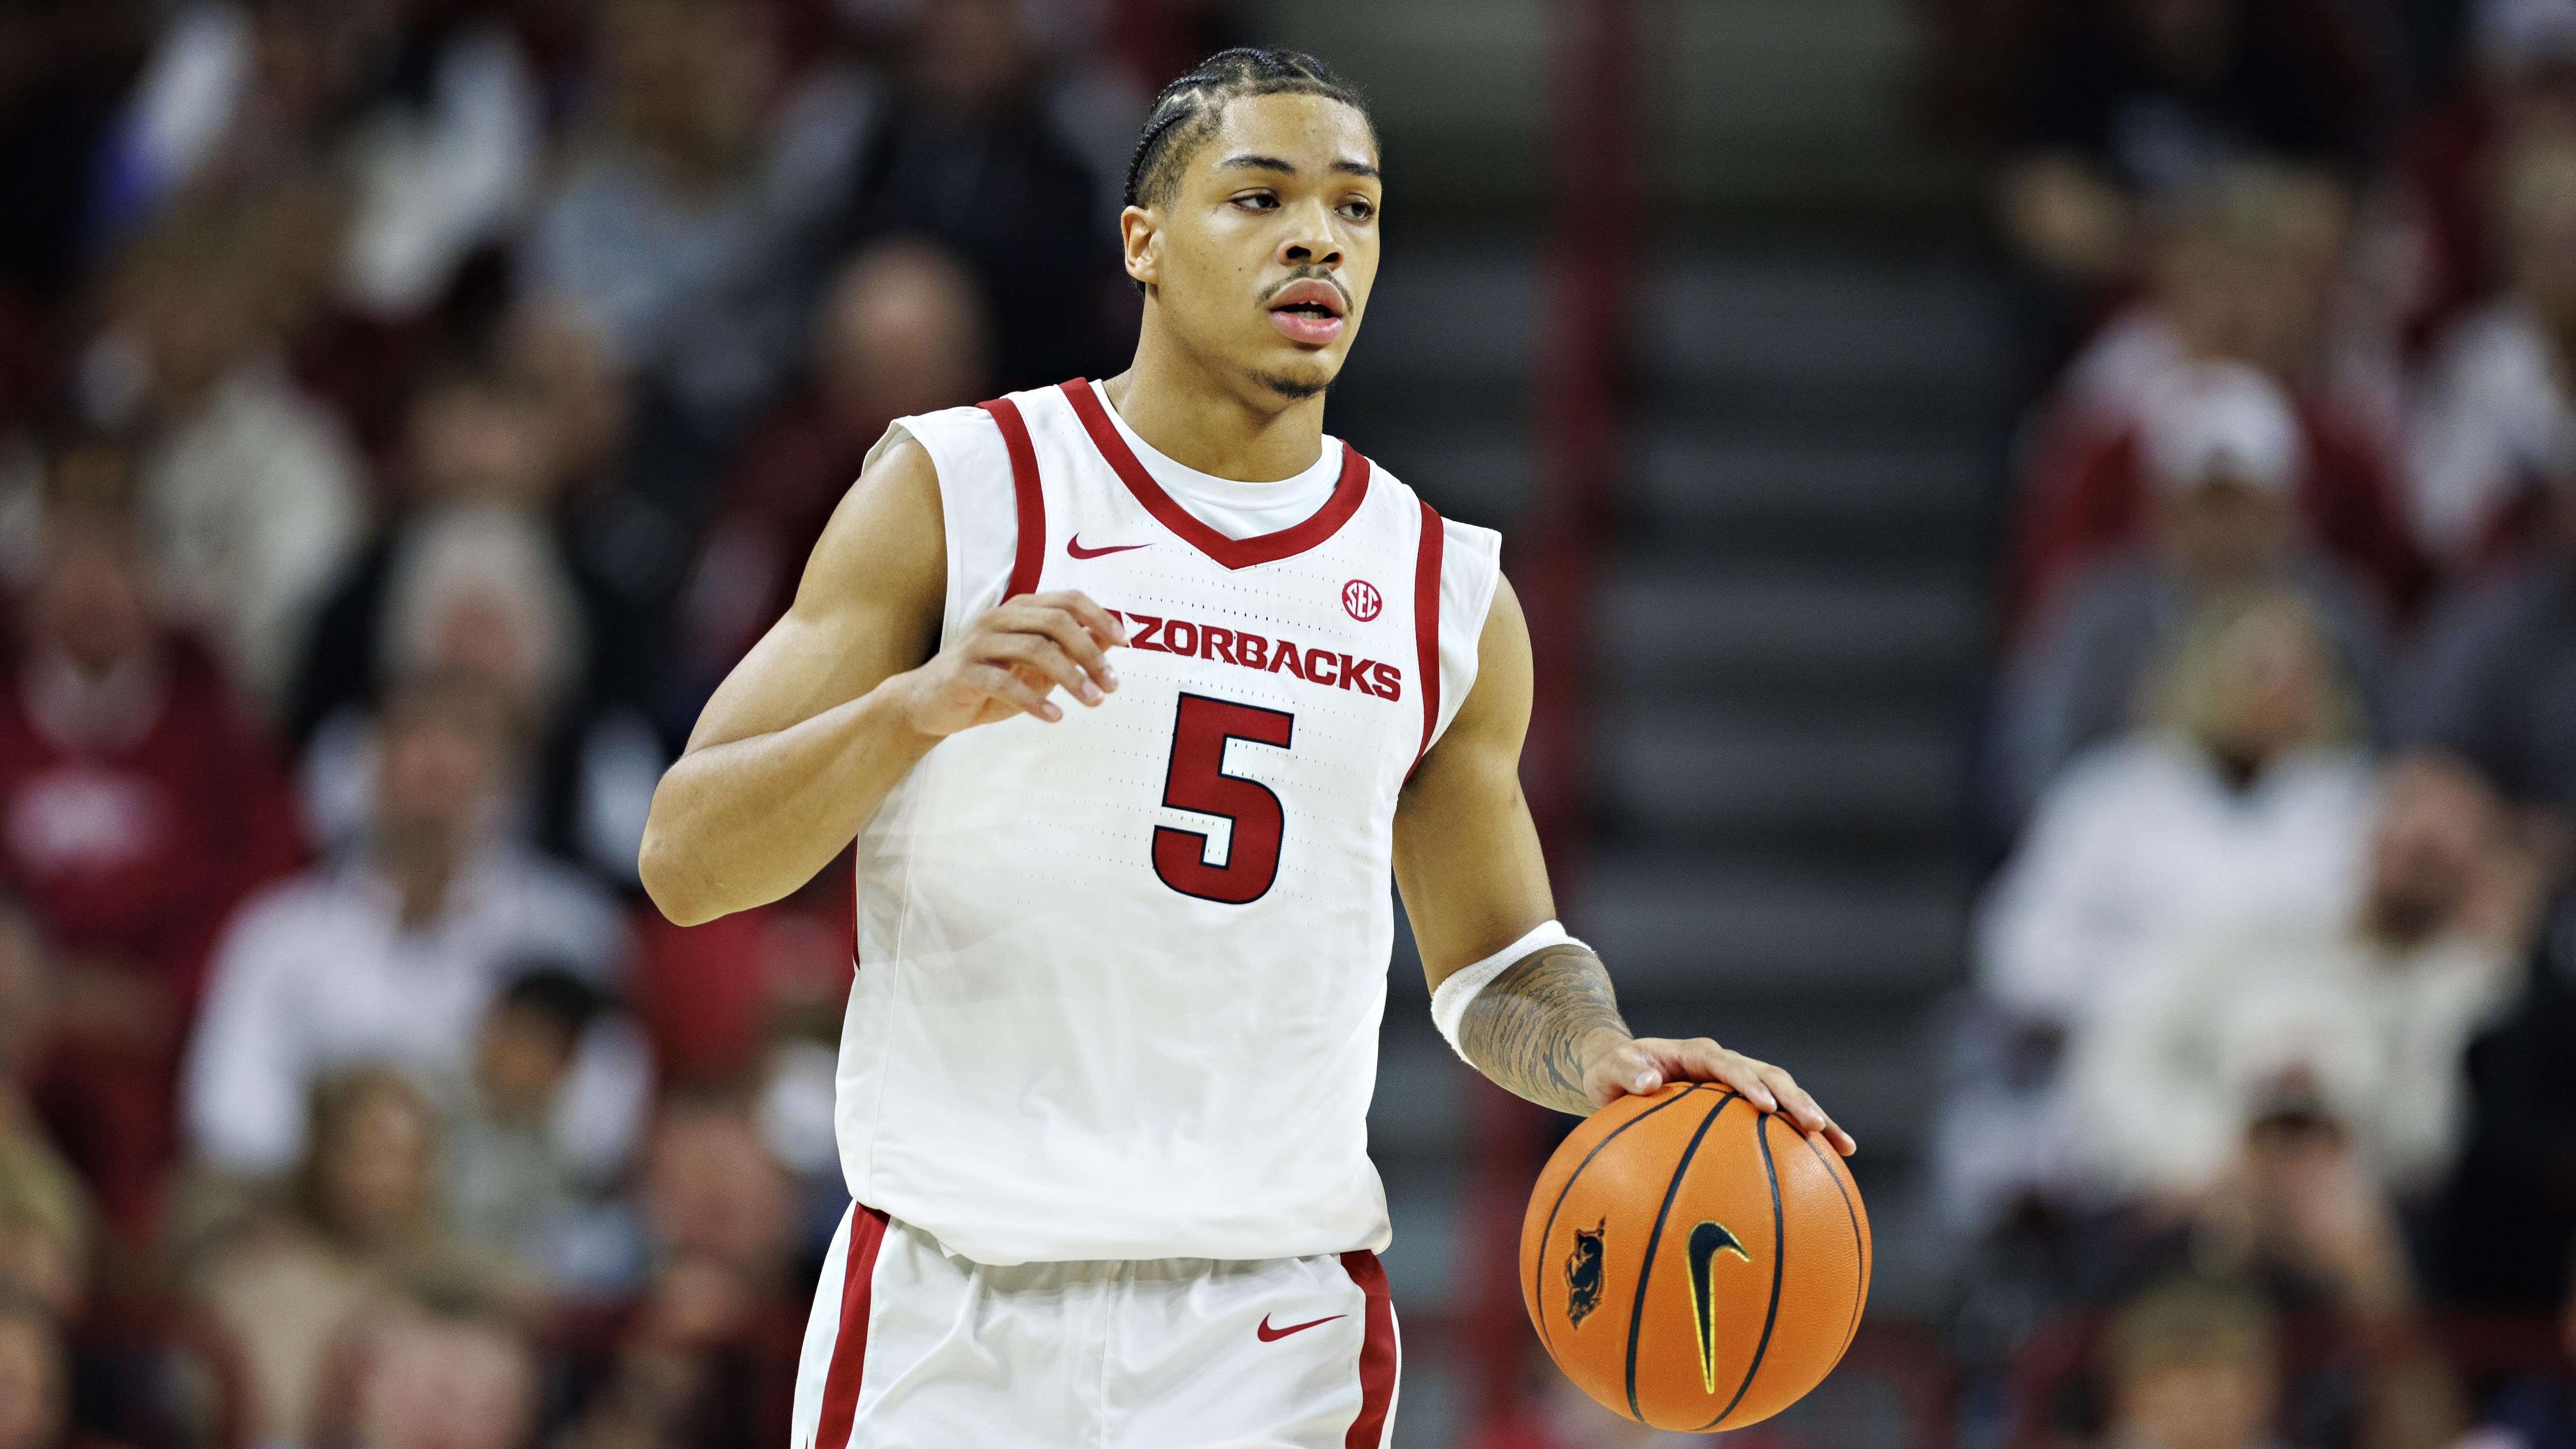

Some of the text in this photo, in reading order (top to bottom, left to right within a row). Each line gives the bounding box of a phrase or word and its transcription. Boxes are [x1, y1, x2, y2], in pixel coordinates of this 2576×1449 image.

[1346, 582, 1379, 618] SEC
[1104, 608, 1401, 702] ZORBACKS
[1151, 692, 1295, 905] 5
